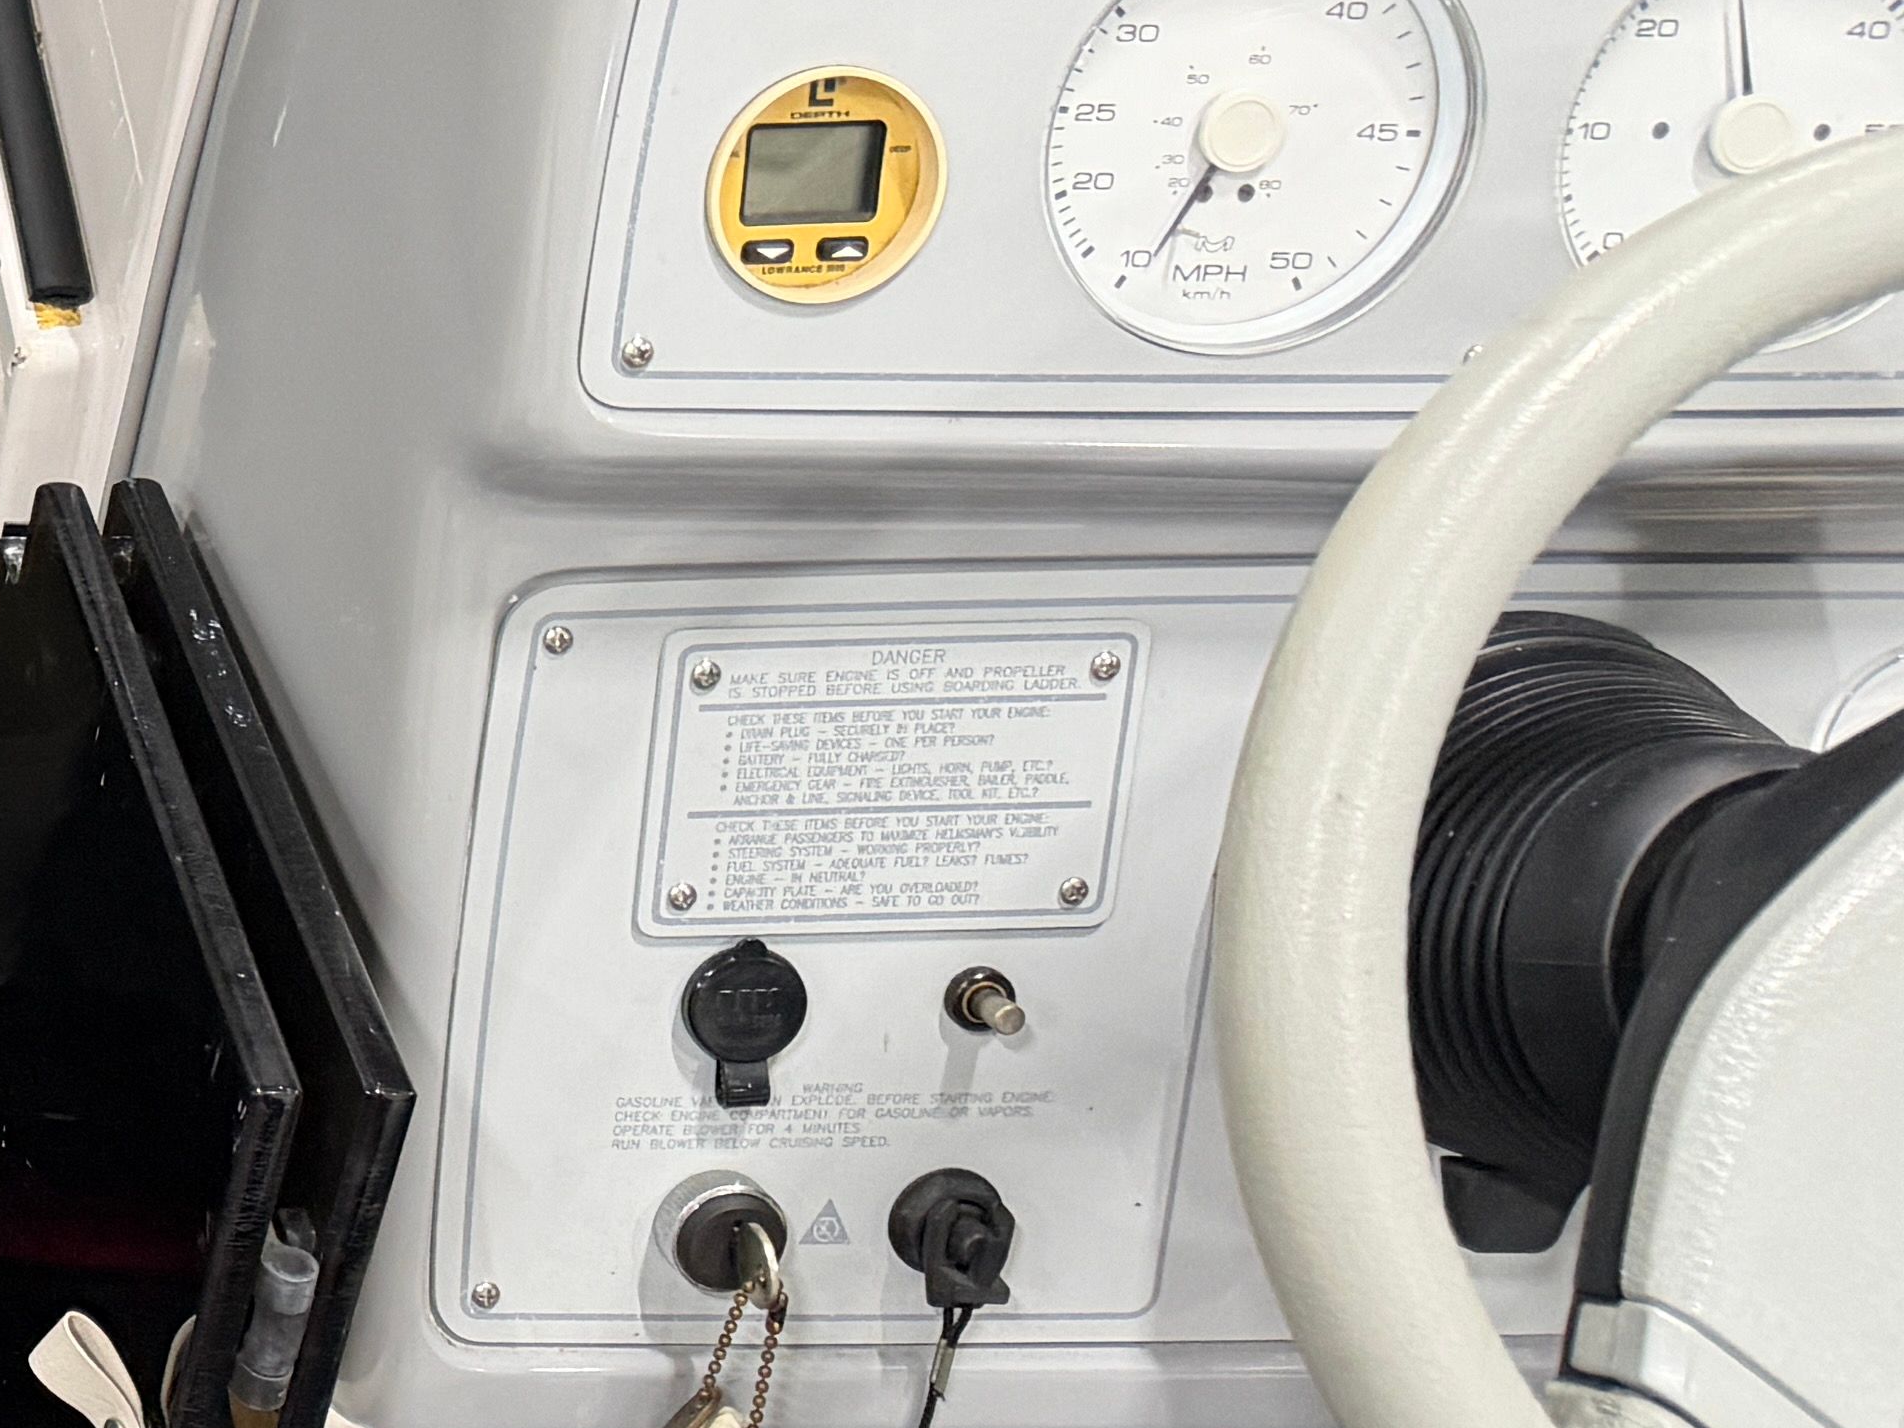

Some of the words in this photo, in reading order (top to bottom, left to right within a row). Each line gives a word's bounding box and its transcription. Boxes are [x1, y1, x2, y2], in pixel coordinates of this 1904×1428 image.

[1325, 2, 1368, 20] 40
[1116, 24, 1160, 42] 30
[1635, 19, 1678, 37] 20
[1846, 21, 1892, 39] 40
[1248, 53, 1271, 65] 60
[1187, 74, 1209, 84] 50
[1074, 104, 1116, 121] 25
[1289, 105, 1311, 115] 70
[1161, 116, 1182, 127] 40
[1356, 123, 1398, 141] 45
[1578, 122, 1611, 140] 10
[1162, 154, 1184, 165] 30
[1072, 173, 1114, 190] 20
[1167, 177, 1190, 188] 20
[1119, 251, 1152, 268] 10
[1269, 252, 1312, 269] 50
[762, 264, 823, 274] LOWRANCE
[1172, 264, 1247, 282] MPH
[1182, 288, 1231, 300] km/h
[872, 649, 946, 666] DANGER
[730, 672, 768, 685] MAKE
[778, 671, 816, 683] SURE
[826, 670, 878, 682] ENGINE
[887, 669, 900, 680] IS
[909, 668, 936, 679] OFF
[944, 667, 973, 678] AND
[984, 665, 1066, 677] PROPELLER
[728, 687, 741, 698] IS
[752, 685, 816, 697] STOPPED
[826, 683, 882, 695] BEFORE
[892, 681, 934, 693] USING
[943, 680, 1015, 693] BOARDING
[1024, 678, 1081, 690] LADDER.
[728, 714, 765, 726] CHECK
[773, 713, 807, 725] THESE
[813, 712, 845, 724] ITEMS
[852, 711, 894, 722] BEFORE
[902, 710, 924, 721] YOU
[931, 708, 964, 719] START
[971, 707, 1001, 718] YOUR
[780, 726, 809, 738] PLUG
[834, 724, 888, 736] SECURELY
[914, 722, 955, 733] PLACE?
[816, 738, 861, 750] DEVICES
[885, 737, 906, 748] ONE
[915, 736, 936, 747] PER
[944, 734, 995, 746] PERSON?
[738, 754, 784, 765] BATTERY
[808, 752, 841, 764] FULLY
[737, 767, 800, 779] ELECTRICAL
[736, 780, 801, 792] EMERGENCY
[808, 779, 836, 790] GEAR
[786, 794, 795, 804] &
[837, 791, 892, 803] SIGNALING
[948, 788, 972, 800] TOOL
[716, 821, 754, 833] CHECK
[805, 819, 837, 831] ITEMS
[844, 817, 889, 829] BEFORE
[896, 816, 919, 827] YOU
[926, 815, 960, 826] START
[967, 814, 998, 825] YOUR
[784, 832, 853, 844] PASSENGERS
[861, 831, 874, 841] TO
[728, 847, 782, 859] STEERING
[790, 845, 832, 857] SYSTEM
[857, 843, 908, 855] WORKING
[915, 841, 981, 853] PROPERLY?
[727, 861, 756, 872] FUEL
[763, 859, 805, 871] SYSTEM
[829, 856, 887, 869] ADEQUATE
[894, 855, 929, 868] FUEL?
[936, 854, 977, 866] LEAKS?
[725, 873, 768, 885] ENGINE
[809, 871, 866, 883] NEUTRAL?
[841, 883, 862, 895] ARE
[870, 883, 892, 894] YOU
[900, 880, 979, 893] OVERLOADED?
[723, 898, 774, 911] WEATHER
[781, 897, 848, 910] CONDITIONS
[872, 896, 899, 907] SAFE
[907, 895, 920, 906] TO
[928, 894, 944, 905] GO
[951, 893, 980, 905] OUT?
[616, 1097, 683, 1108] GASOLINE
[867, 1093, 920, 1105] BEFORE
[930, 1092, 993, 1105] STARTING
[614, 1111, 660, 1122] CHECK
[671, 1110, 720, 1122] ENGINE
[839, 1109, 865, 1119] FOR
[875, 1107, 940, 1119] GASOLINE
[948, 1107, 968, 1118] OR
[612, 1125, 673, 1136] OPERATE
[683, 1124, 738, 1135] BLOWER
[748, 1123, 775, 1134] FOR
[784, 1124, 792, 1134] 4
[612, 1139, 640, 1149] RUN
[650, 1138, 706, 1149] BLOWER
[715, 1138, 760, 1149] BELOW
[769, 1137, 833, 1148] CRUISING
